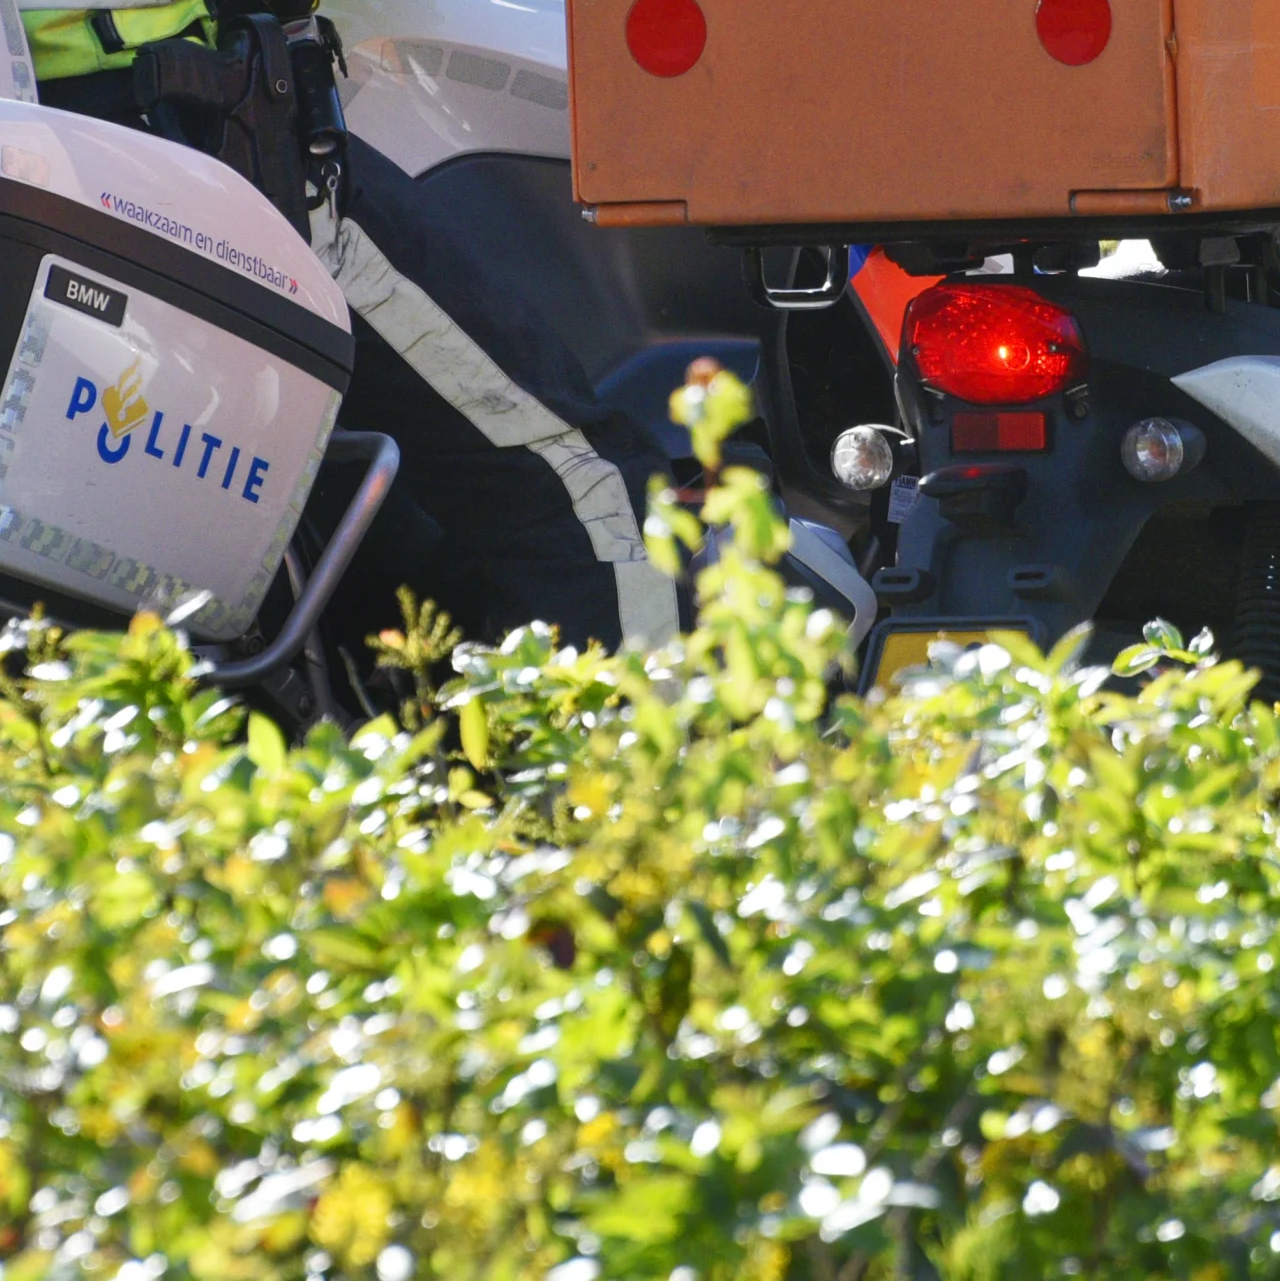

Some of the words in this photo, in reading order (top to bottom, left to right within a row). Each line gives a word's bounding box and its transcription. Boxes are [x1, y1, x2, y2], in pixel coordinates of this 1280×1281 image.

[195, 232, 213, 253] en
[66, 279, 111, 312] BMW
[65, 376, 270, 504] POLITIE
